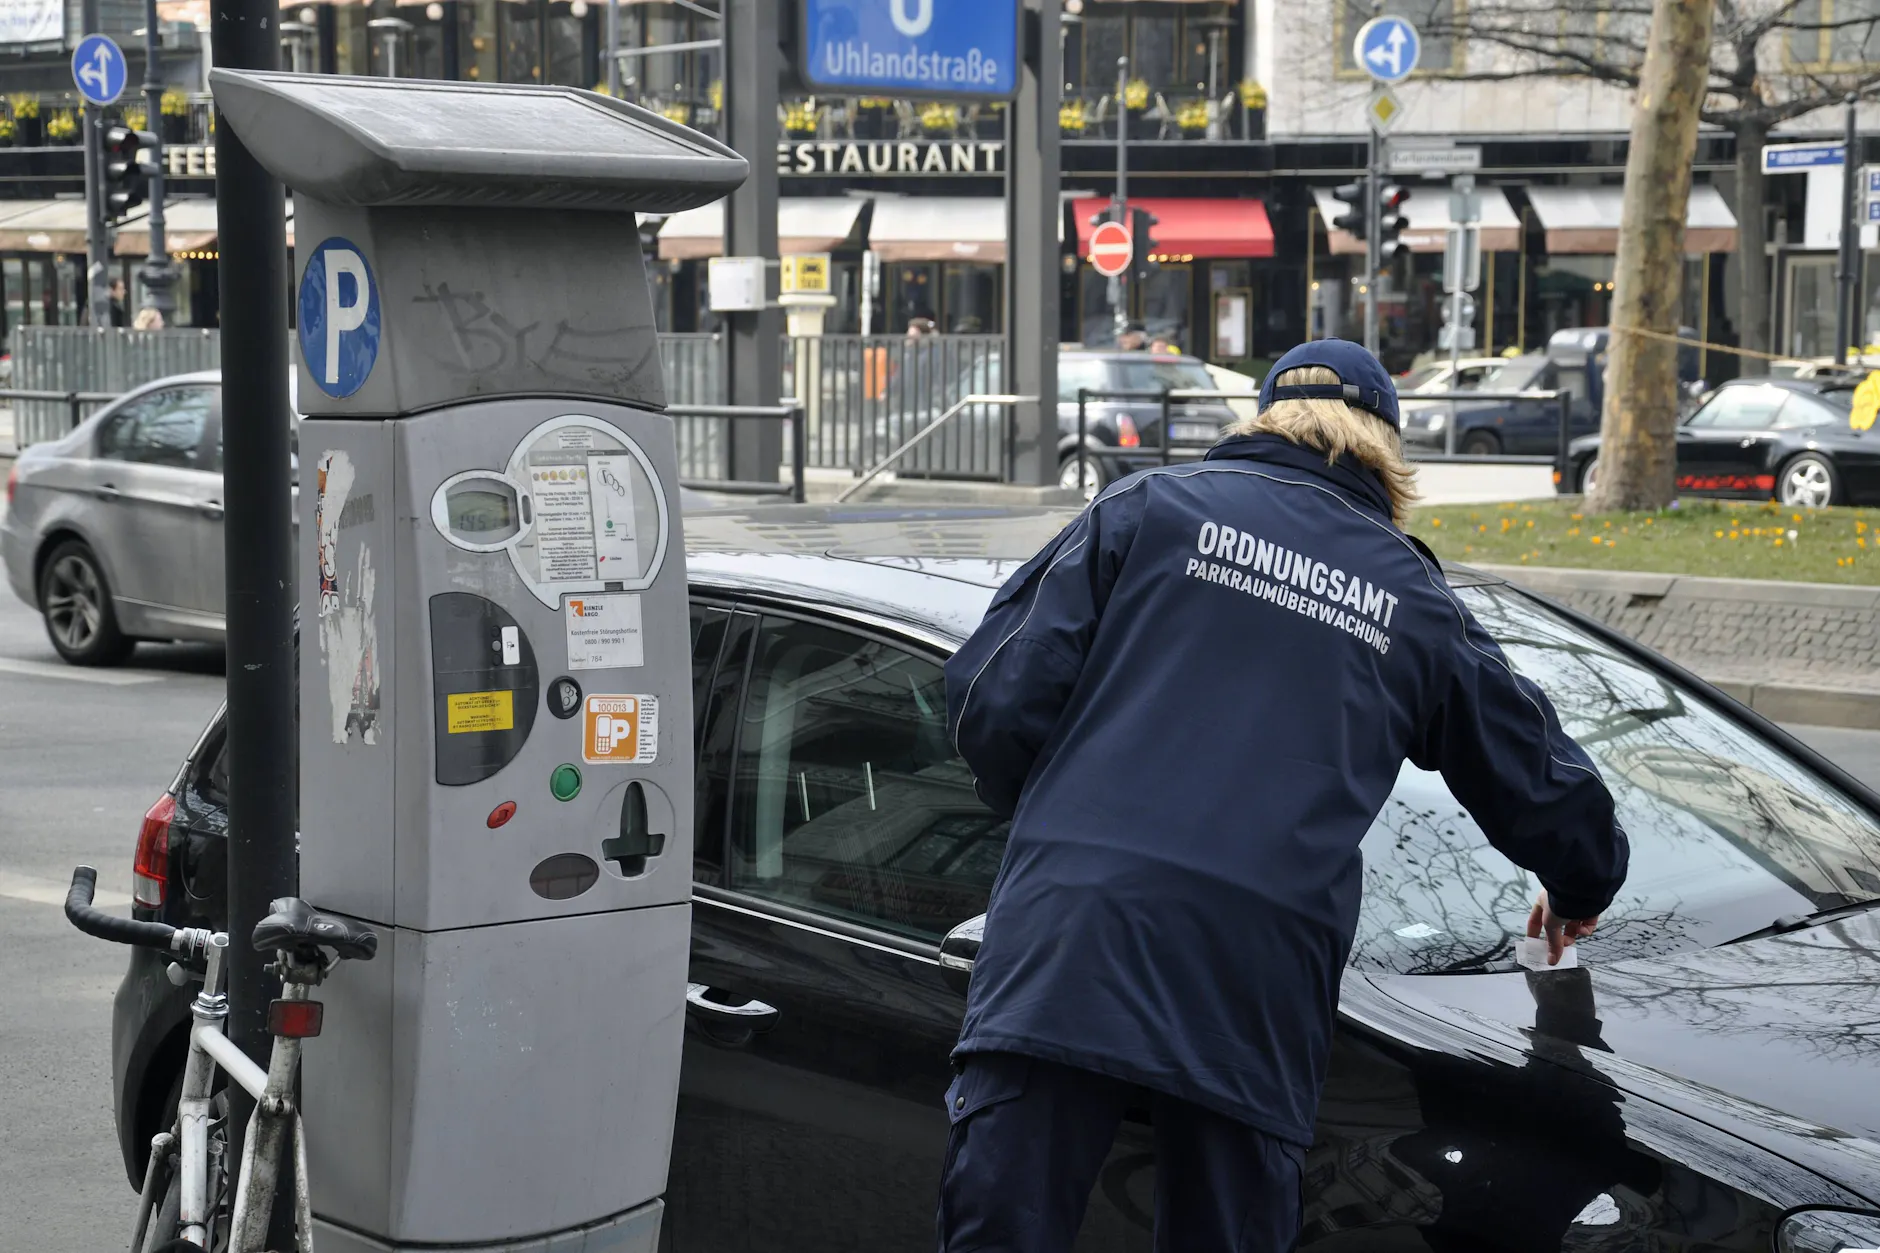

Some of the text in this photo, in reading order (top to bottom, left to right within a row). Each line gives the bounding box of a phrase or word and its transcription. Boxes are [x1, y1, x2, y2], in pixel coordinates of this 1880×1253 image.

[826, 40, 997, 84] Uhlandstraße
[324, 249, 370, 384] P
[1186, 557, 1392, 655] PARKRAUMÜBERWACHUNG
[1198, 521, 1399, 628] ORDNUNGSAMT
[598, 704, 626, 712] 100 013
[611, 719, 630, 748] P
